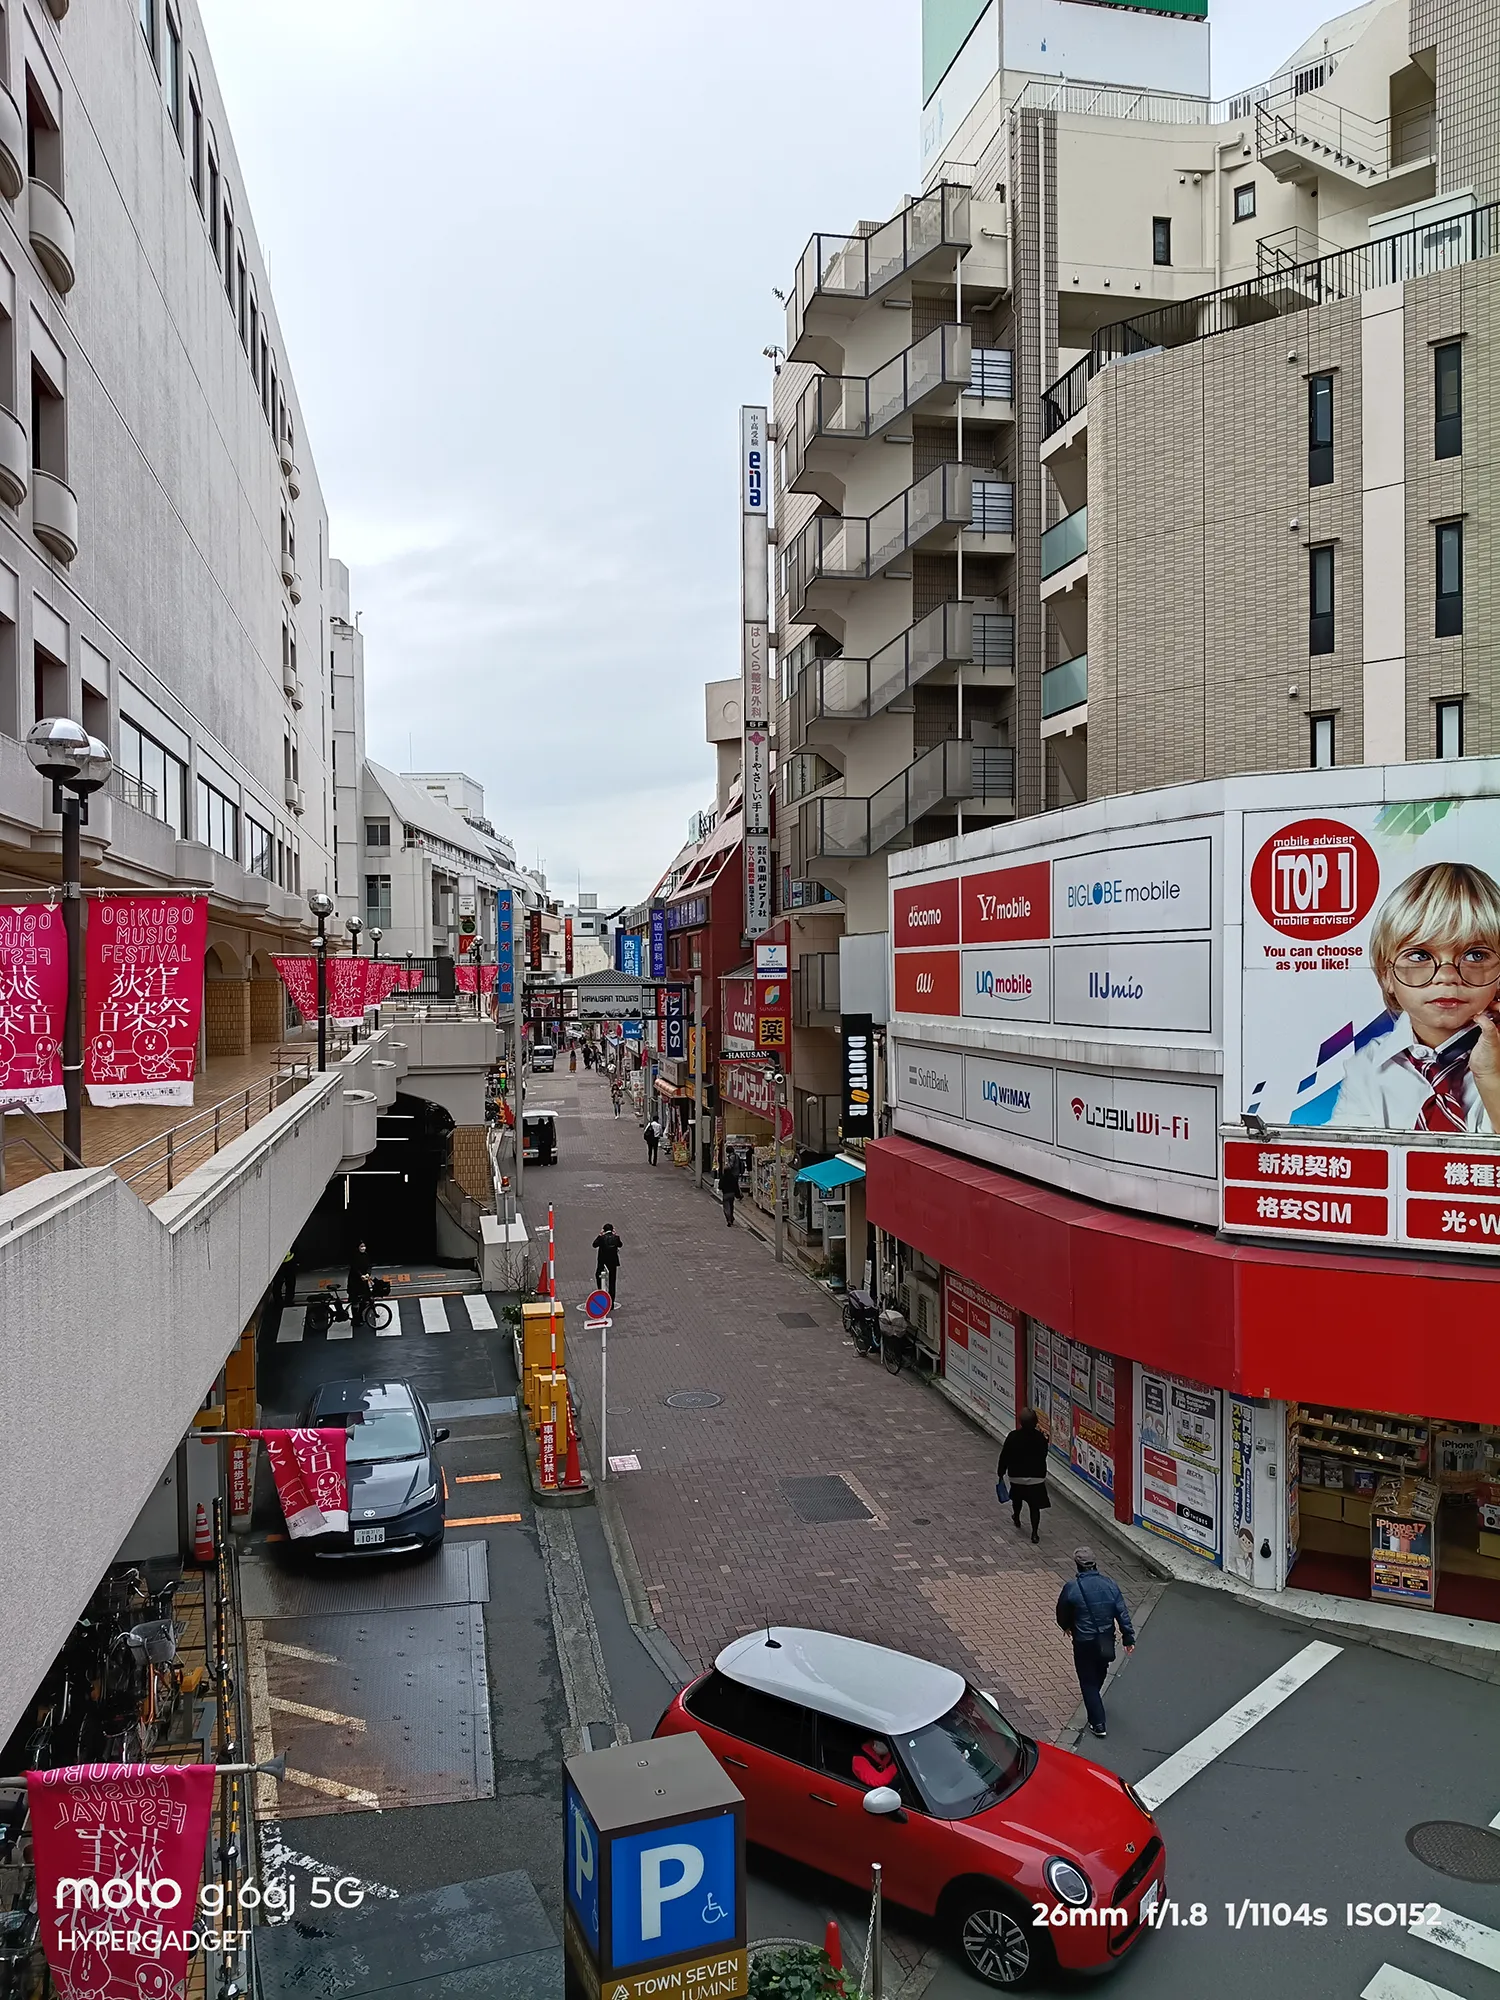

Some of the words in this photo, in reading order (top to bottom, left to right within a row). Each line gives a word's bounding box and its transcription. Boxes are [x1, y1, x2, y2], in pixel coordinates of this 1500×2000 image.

[749, 451, 761, 507] ena
[751, 626, 762, 718] はしくら整形外科
[752, 762, 763, 812] やさしい手
[1273, 836, 1309, 847] mobile
[1313, 834, 1355, 845] adviser
[1068, 880, 1122, 908] BIGLOBE
[1125, 880, 1181, 903] mobile
[1277, 853, 1328, 911] TOP
[1337, 853, 1350, 909] 1
[102, 906, 195, 927] OGIKUBO
[908, 907, 942, 928] docomo
[1273, 915, 1309, 926] mobile
[1313, 914, 1355, 925] adviser
[116, 926, 178, 945] MUSIC
[101, 944, 192, 963] FESTIVAL
[1263, 946, 1286, 957] You
[1289, 948, 1313, 957] can
[1316, 945, 1363, 957] choose
[1276, 961, 1291, 970] as
[1295, 961, 1317, 973] you
[1321, 959, 1349, 970] like!
[109, 963, 179, 998] 荻窪
[916, 972, 934, 994] au
[976, 970, 994, 997] UQ
[995, 973, 1032, 994] mobile
[581, 994, 613, 1003] HAKUSAN
[743, 981, 753, 1006] 2F
[95, 997, 191, 1034] 音楽祭
[733, 1011, 756, 1034] COSME
[761, 1019, 783, 1042] 薬
[728, 1051, 768, 1060] HAKUSAN
[848, 1036, 870, 1117] DOUTOR
[918, 1066, 950, 1093] SoftBank
[982, 1080, 999, 1106] UQ
[999, 1085, 1031, 1110] WiMAX
[1258, 1152, 1352, 1179] 新規契約
[1444, 1162, 1500, 1188] 機種
[1257, 1196, 1352, 1224] 格安SIM
[1099, 1353, 1113, 1366] SALE
[543, 1425, 555, 1483] 車路歩行禁止
[1442, 1439, 1474, 1449] iPhone
[233, 1449, 245, 1511] 車路歩行禁止
[1376, 1518, 1412, 1531] iPhone
[1413, 1523, 1426, 1533] 17
[1386, 1529, 1416, 1540] シリーズ
[361, 1533, 384, 1544] 10-18
[575, 1811, 594, 1900] P
[640, 1843, 705, 1941] P
[634, 1971, 682, 1996] TOWN
[686, 1958, 738, 1984] SEVEN
